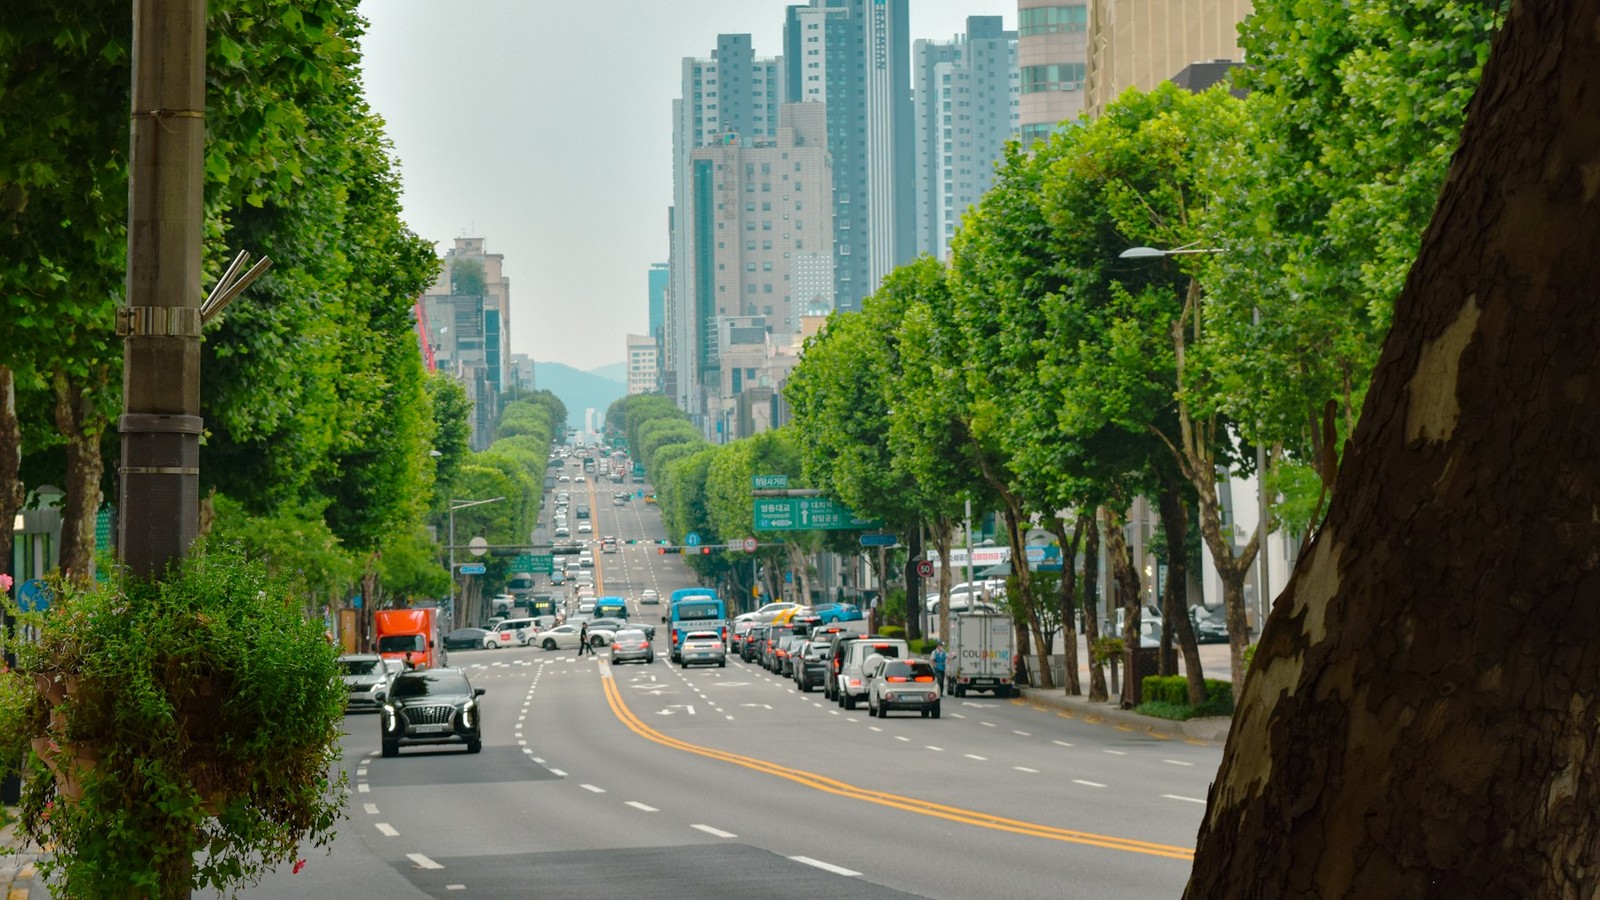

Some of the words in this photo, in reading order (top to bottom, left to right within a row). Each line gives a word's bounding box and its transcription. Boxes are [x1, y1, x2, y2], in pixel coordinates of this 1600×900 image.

[756, 477, 786, 487] 청담사거리
[761, 504, 790, 513] 영동대교
[920, 565, 930, 573] 50
[963, 650, 1008, 661] coupang
